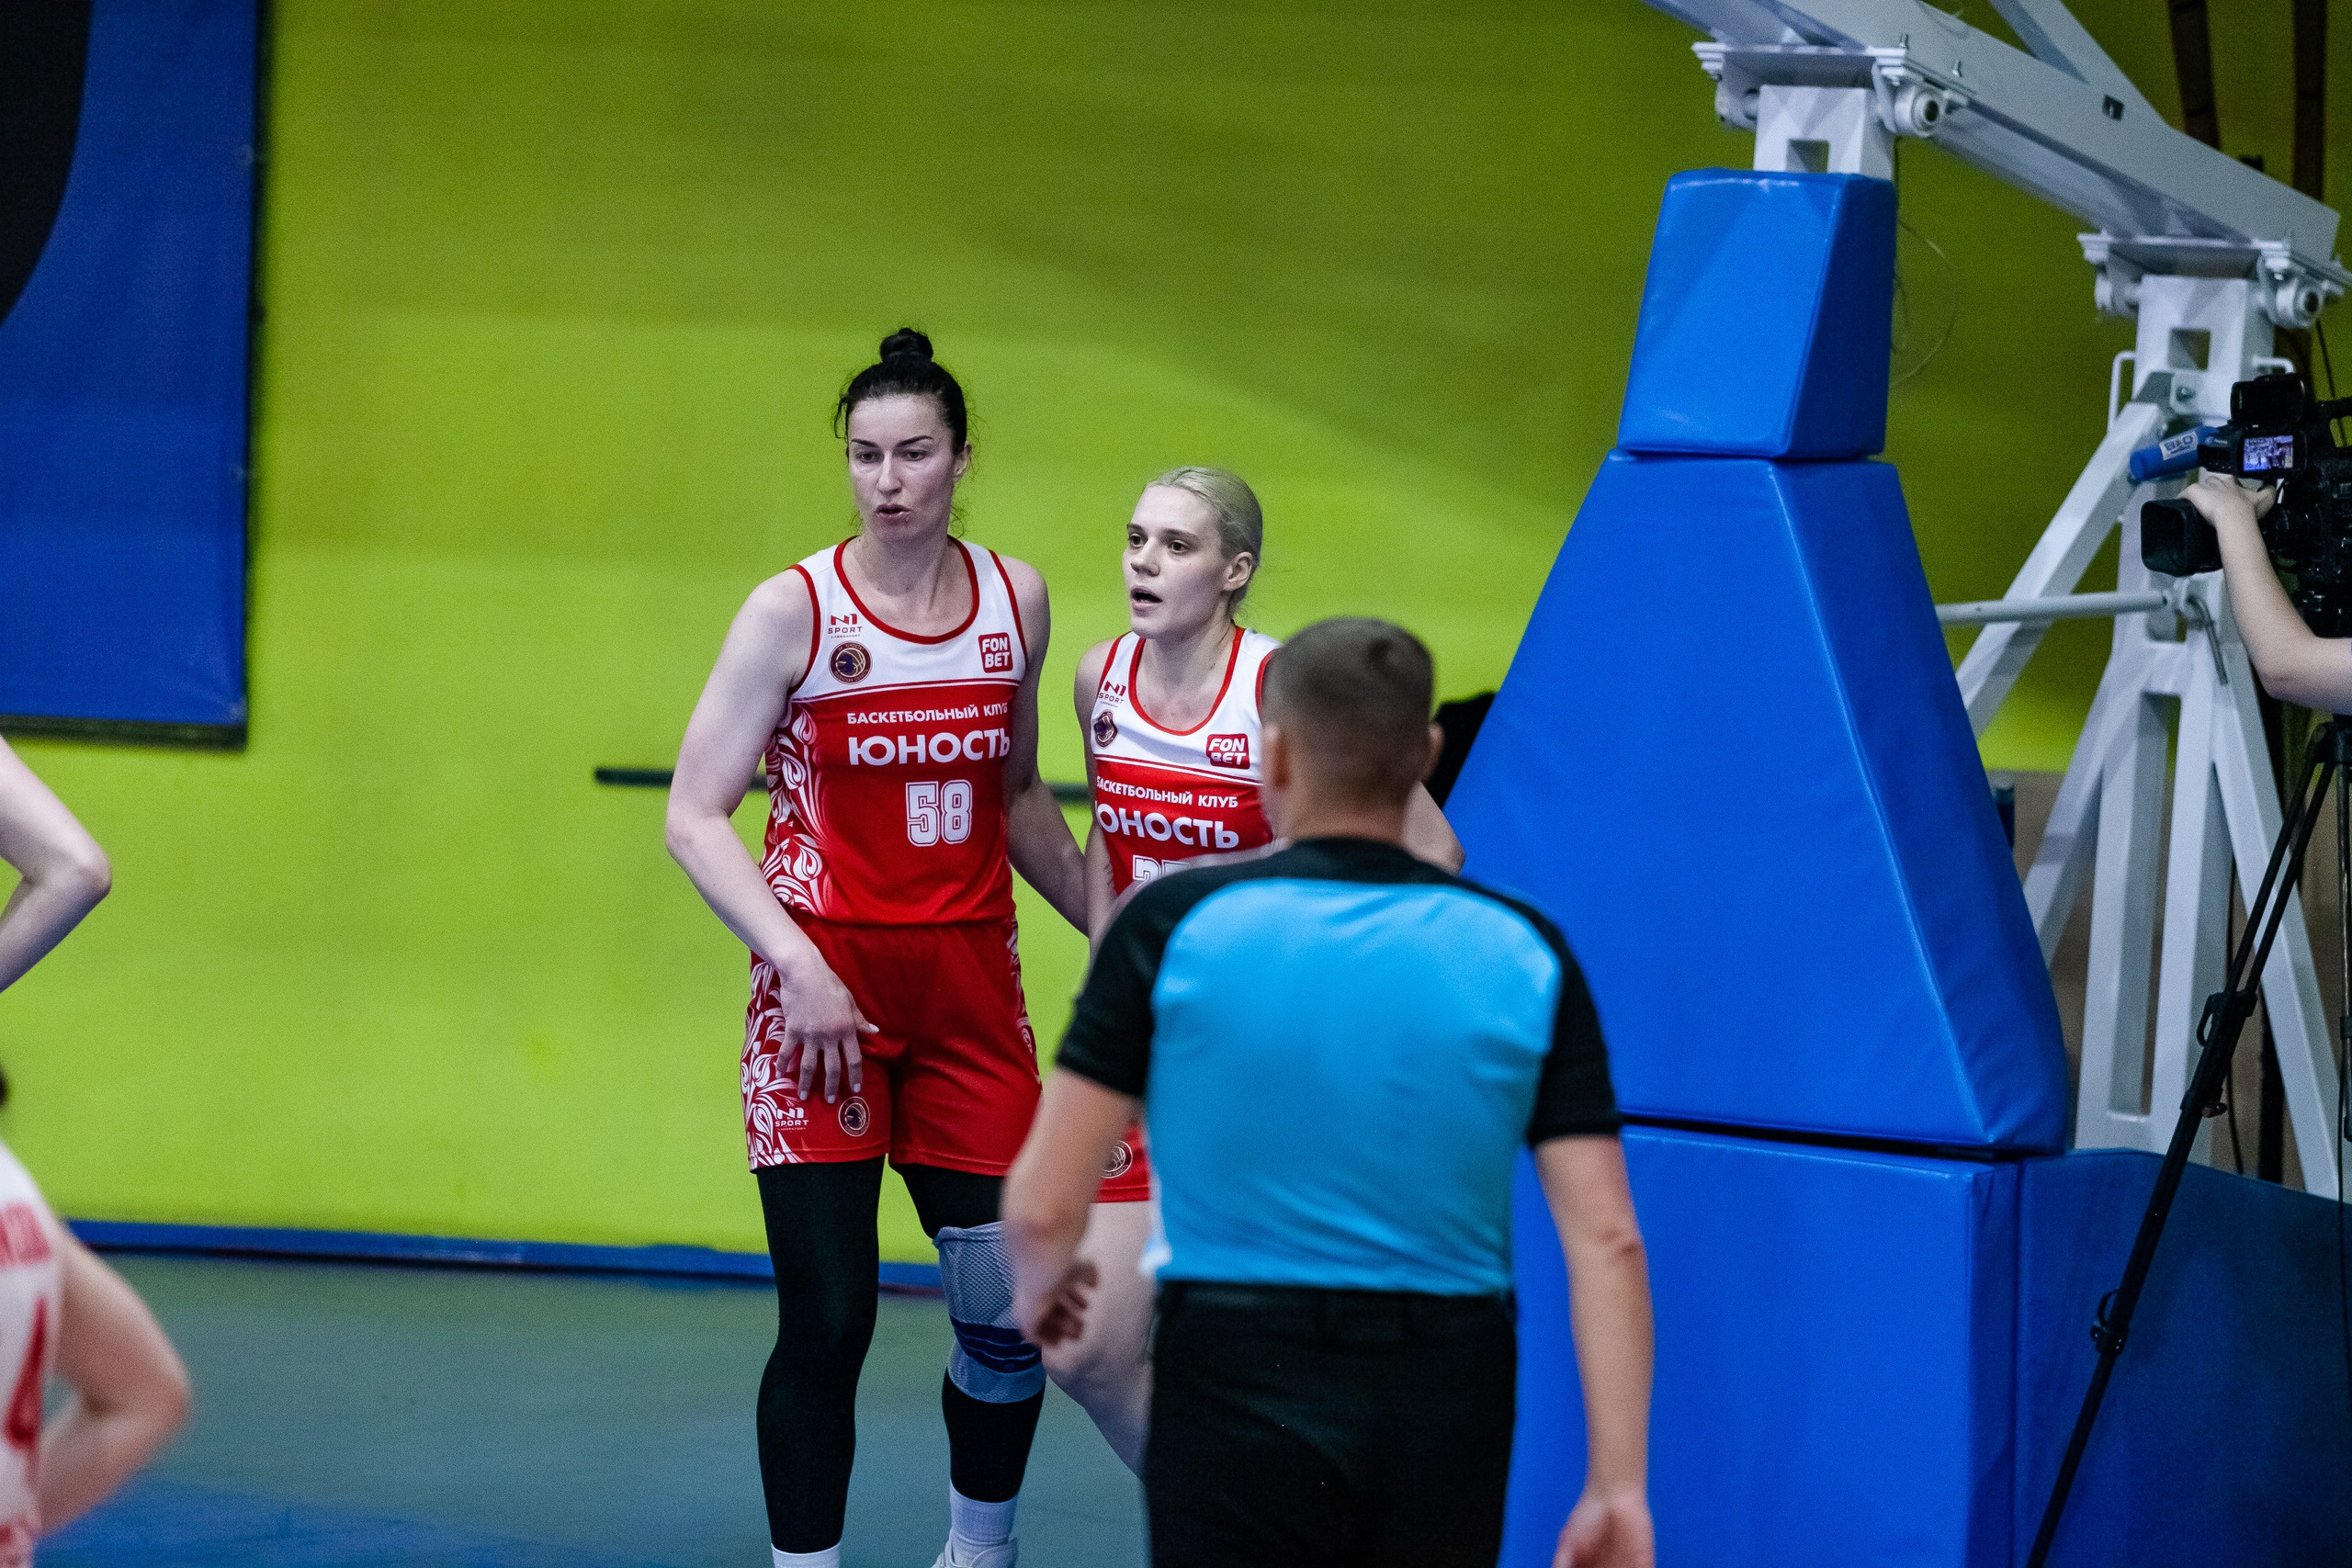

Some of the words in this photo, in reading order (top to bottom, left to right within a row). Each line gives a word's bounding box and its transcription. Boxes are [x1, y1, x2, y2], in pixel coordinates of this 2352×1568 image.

[827, 626, 863, 635] SPORT
[982, 637, 1009, 653] FON
[985, 651, 1011, 669] BET
[1098, 692, 1125, 705] SPORT
[847, 704, 979, 725] БАСКЕТБОЛЬНЫЙ
[983, 703, 1009, 717] КЛУБ
[848, 727, 1012, 767] ЮНОСТЬ
[1208, 738, 1246, 752] FON
[1210, 751, 1247, 765] BET
[1096, 775, 1193, 806] БАСКЕТБОЛЬНЫЙ
[1197, 795, 1238, 808] КЛУБ
[906, 779, 973, 847] 58
[775, 1119, 809, 1127] SPORT
